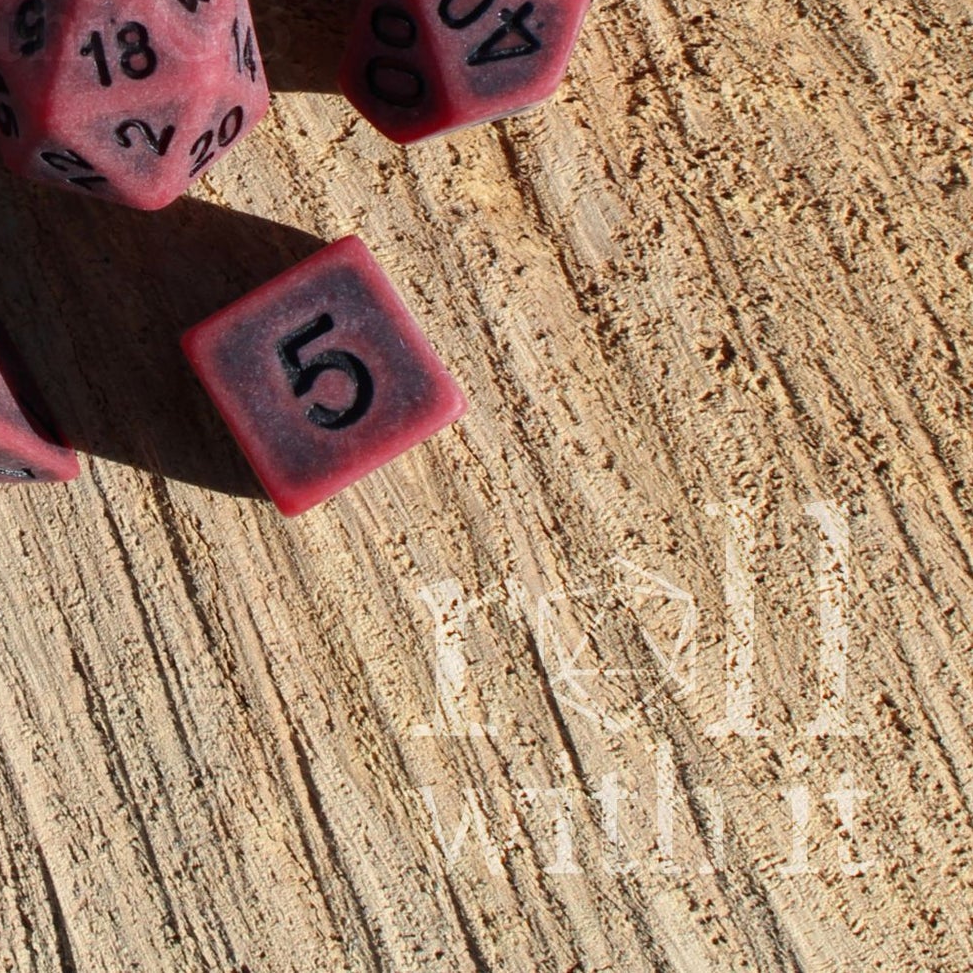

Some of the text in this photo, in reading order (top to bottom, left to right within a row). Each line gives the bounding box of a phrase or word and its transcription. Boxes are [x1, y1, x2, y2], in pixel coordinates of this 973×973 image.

[80, 20, 158, 88] 18
[113, 118, 176, 157] 2
[188, 105, 243, 178] 20
[275, 312, 375, 431] 5
